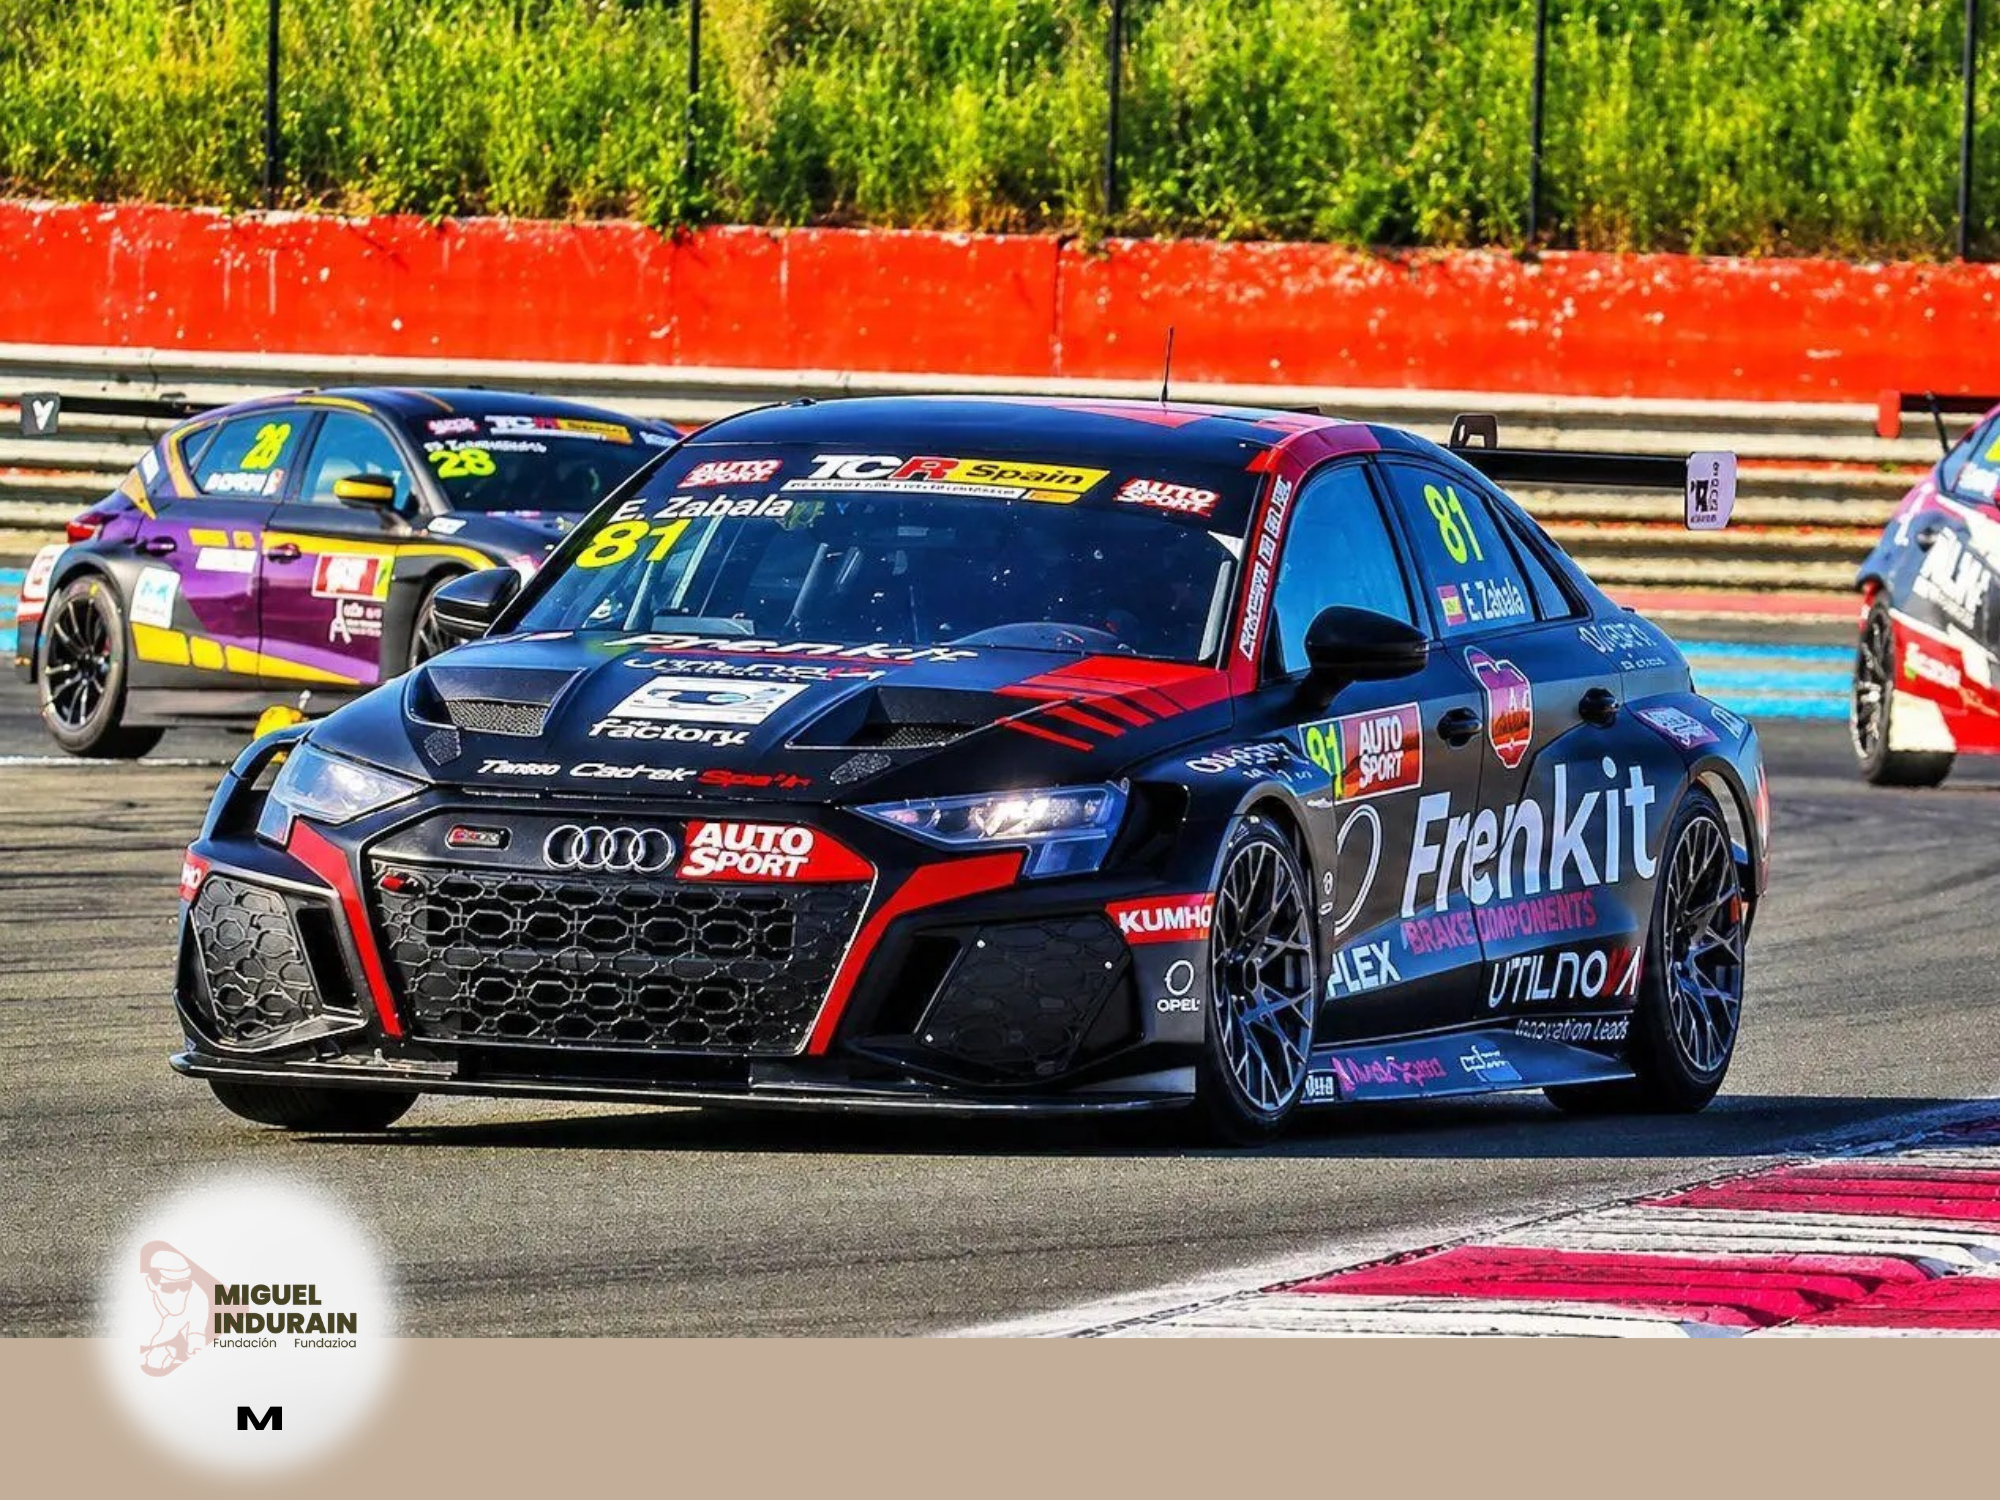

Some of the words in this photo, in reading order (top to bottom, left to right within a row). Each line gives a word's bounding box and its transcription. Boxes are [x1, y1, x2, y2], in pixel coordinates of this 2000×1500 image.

[240, 423, 291, 469] 28
[428, 447, 497, 479] 28
[697, 459, 781, 476] AUTO
[808, 454, 960, 481] TCR
[965, 463, 1084, 487] Spain
[1118, 489, 1210, 514] SPORT
[1128, 478, 1217, 504] AUTO
[610, 498, 646, 522] E.
[653, 494, 796, 520] Zabala
[1423, 484, 1484, 564] 81
[575, 518, 691, 569] 81
[1461, 581, 1484, 621] E.
[1475, 577, 1525, 620] Zabala
[1359, 715, 1403, 756] AUTO
[1359, 751, 1404, 788] SPORT
[691, 822, 814, 855] AUTO
[1401, 756, 1657, 918] Frenkit
[681, 847, 809, 877] SPORT
[1118, 904, 1212, 933] KUMHO
[1405, 911, 1477, 955] BRAKE
[1156, 997, 1200, 1013] OPEL
[1594, 1015, 1630, 1041] Leads
